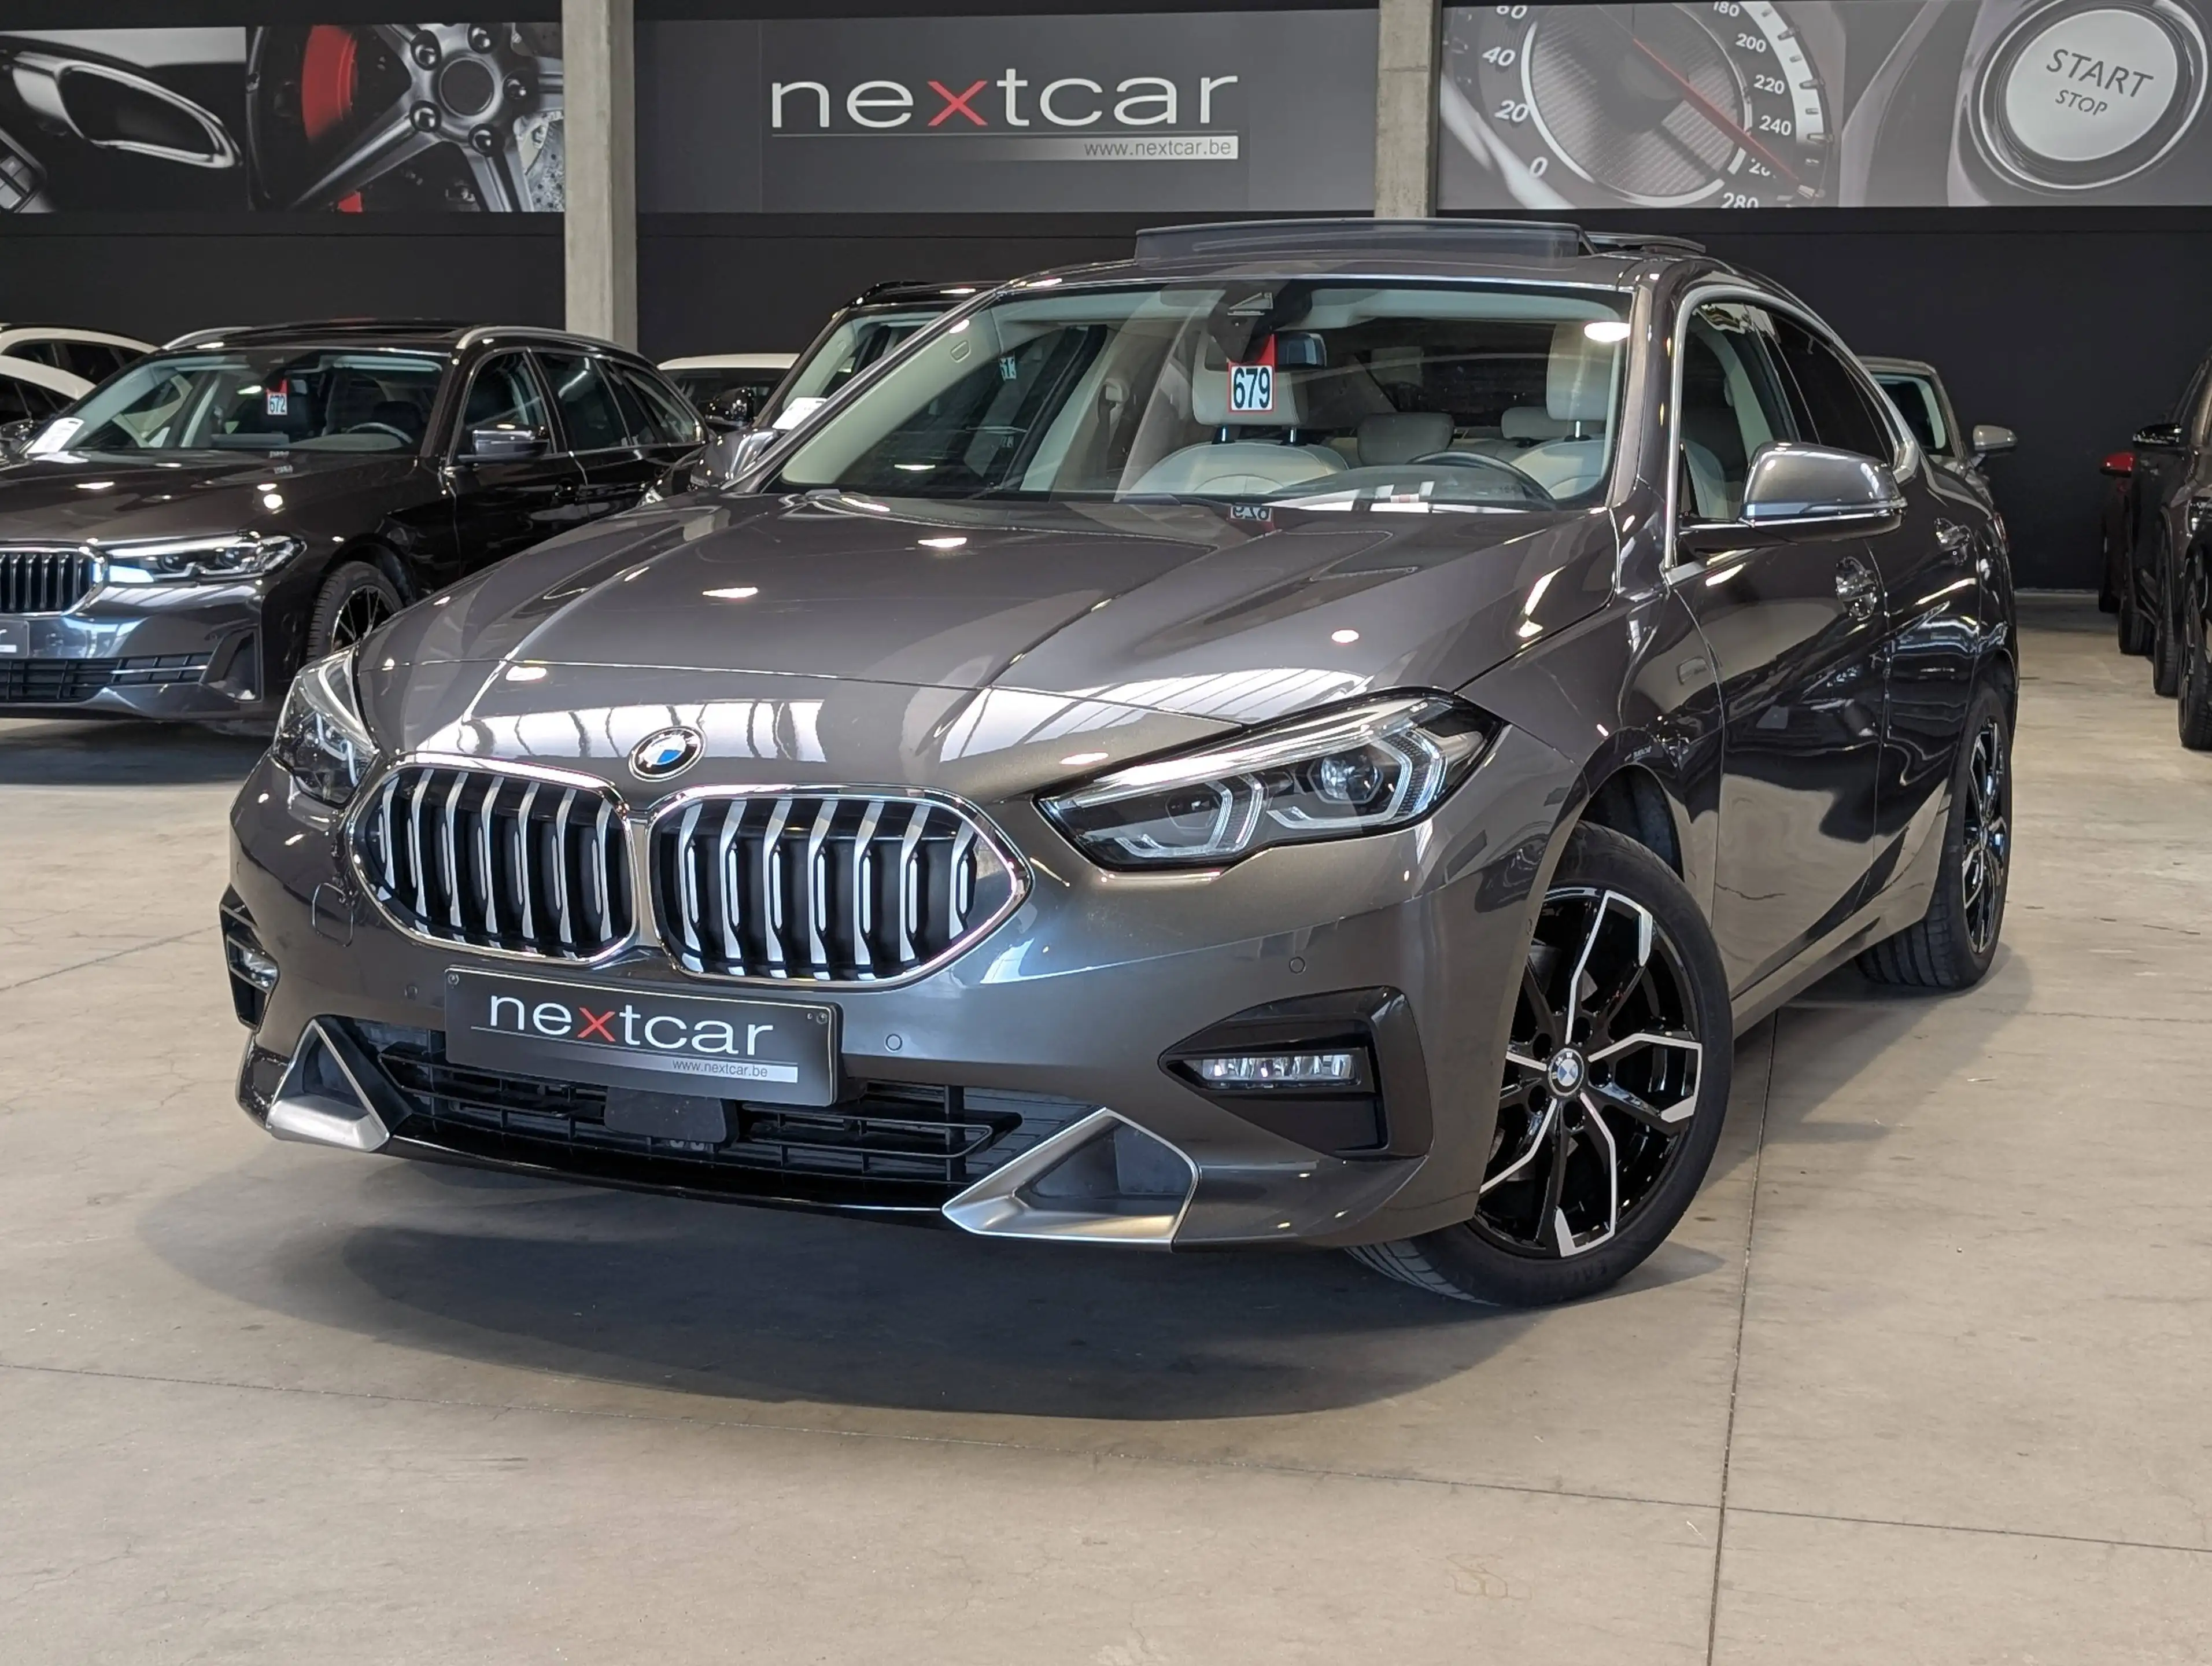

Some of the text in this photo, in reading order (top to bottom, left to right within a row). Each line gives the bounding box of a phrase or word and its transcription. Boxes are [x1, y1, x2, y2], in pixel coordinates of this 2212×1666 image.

[1735, 33, 1766, 53] 200
[1482, 46, 1515, 66] 40
[2047, 49, 2154, 98] START
[1753, 75, 1785, 95] 220
[771, 68, 1238, 128] nextcar
[2055, 90, 2108, 116] STOP
[1495, 100, 1528, 123] 20
[1759, 115, 1792, 136] 240
[1084, 138, 1232, 158] www.nextcar.be
[1529, 157, 1548, 178] 0
[1233, 367, 1270, 408] 679
[269, 396, 286, 413] 672
[490, 994, 773, 1056] nextcar
[672, 1059, 769, 1078] www.nextcar.be
